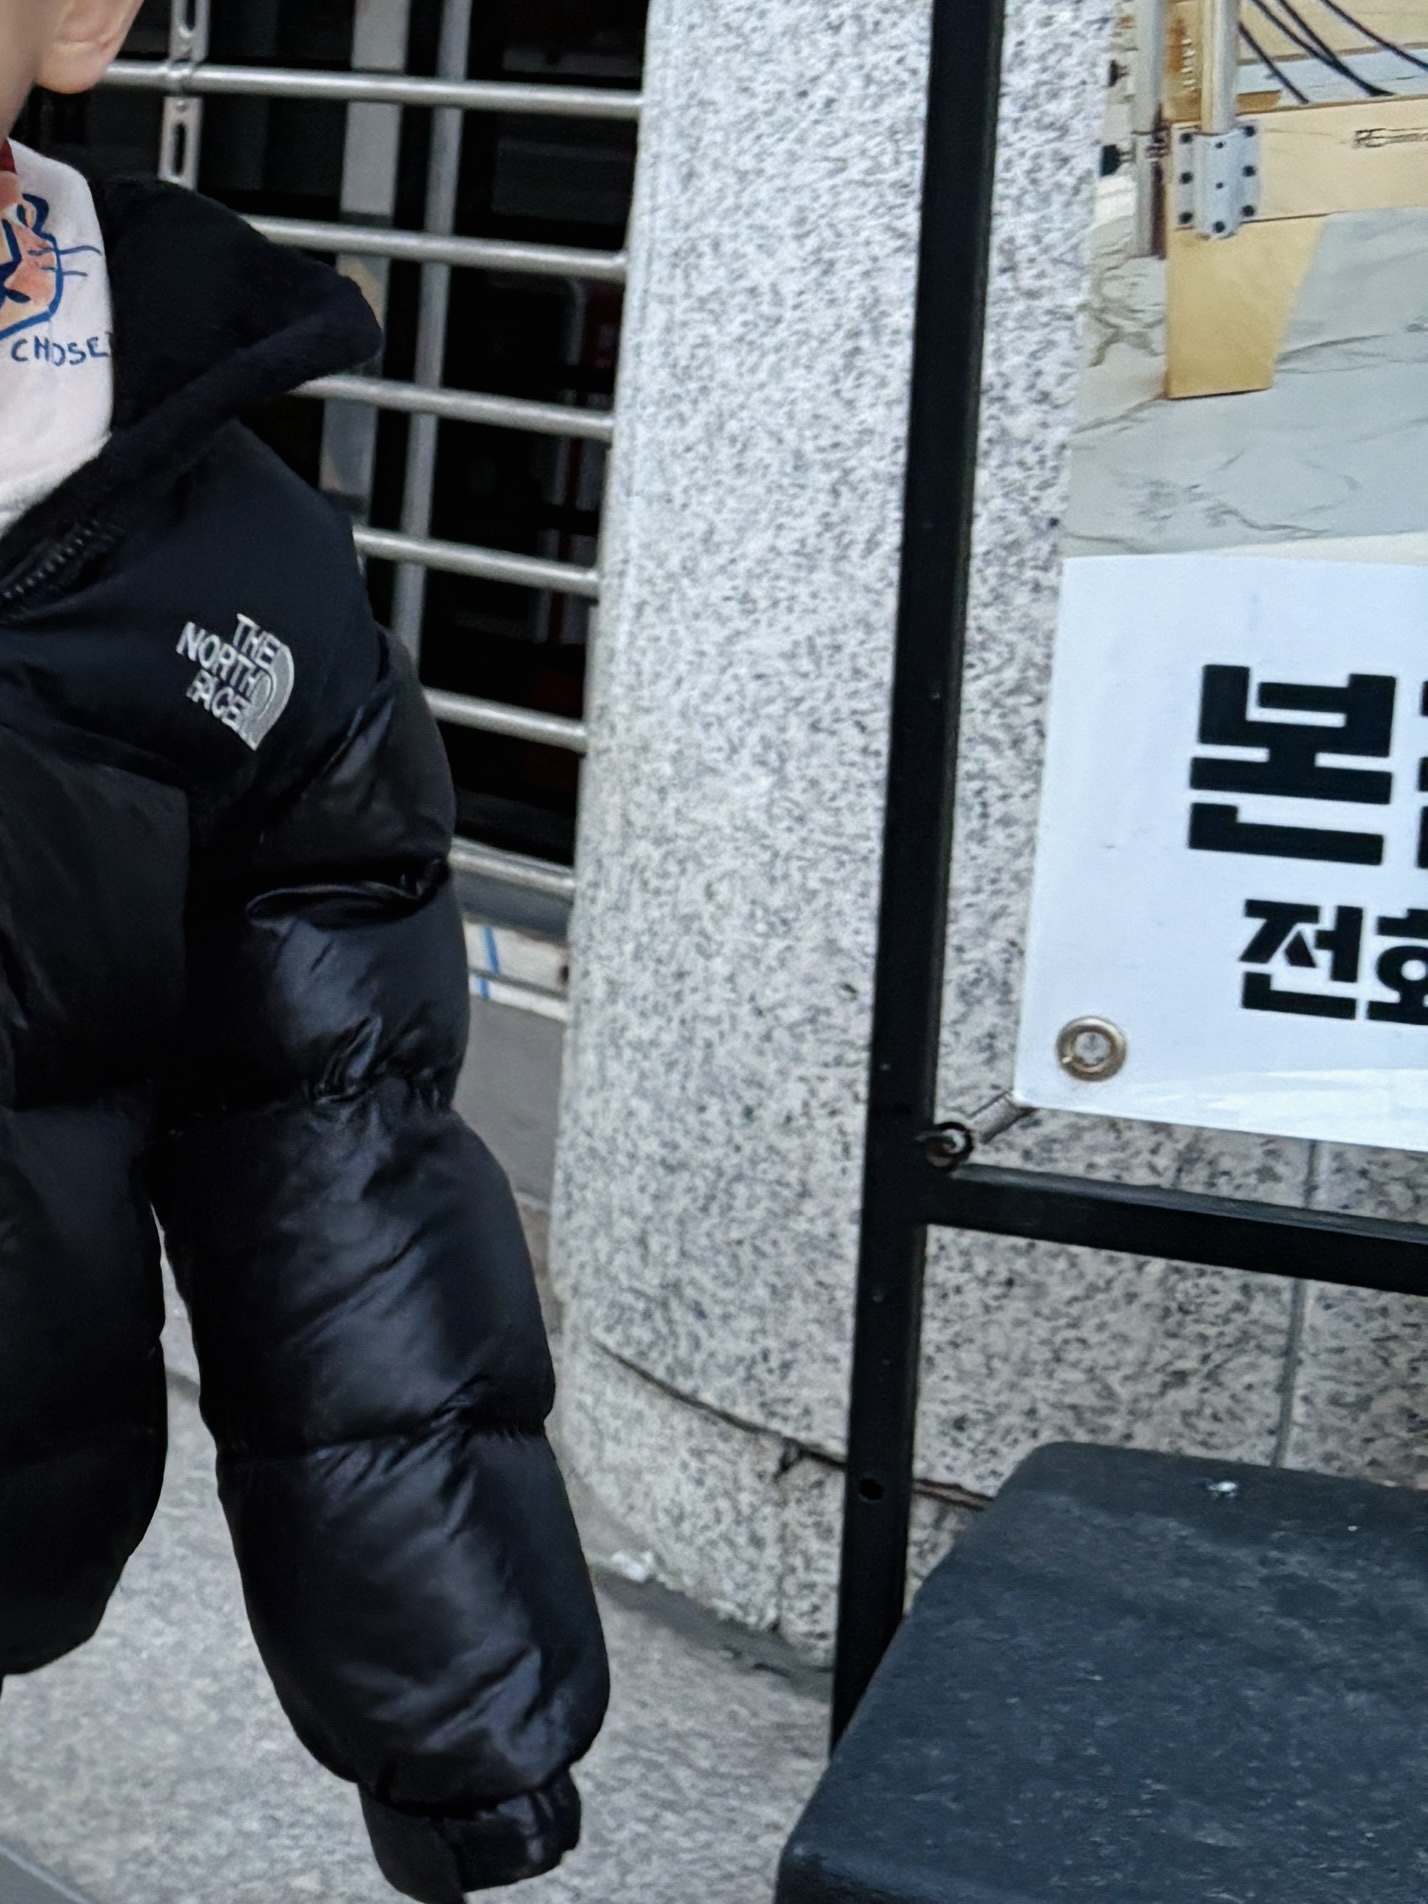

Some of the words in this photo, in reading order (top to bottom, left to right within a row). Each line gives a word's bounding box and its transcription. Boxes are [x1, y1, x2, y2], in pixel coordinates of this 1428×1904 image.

[175, 621, 269, 699] NORTH
[233, 612, 282, 671] THE
[186, 668, 252, 733] FACE
[1186, 662, 1428, 874] 본
